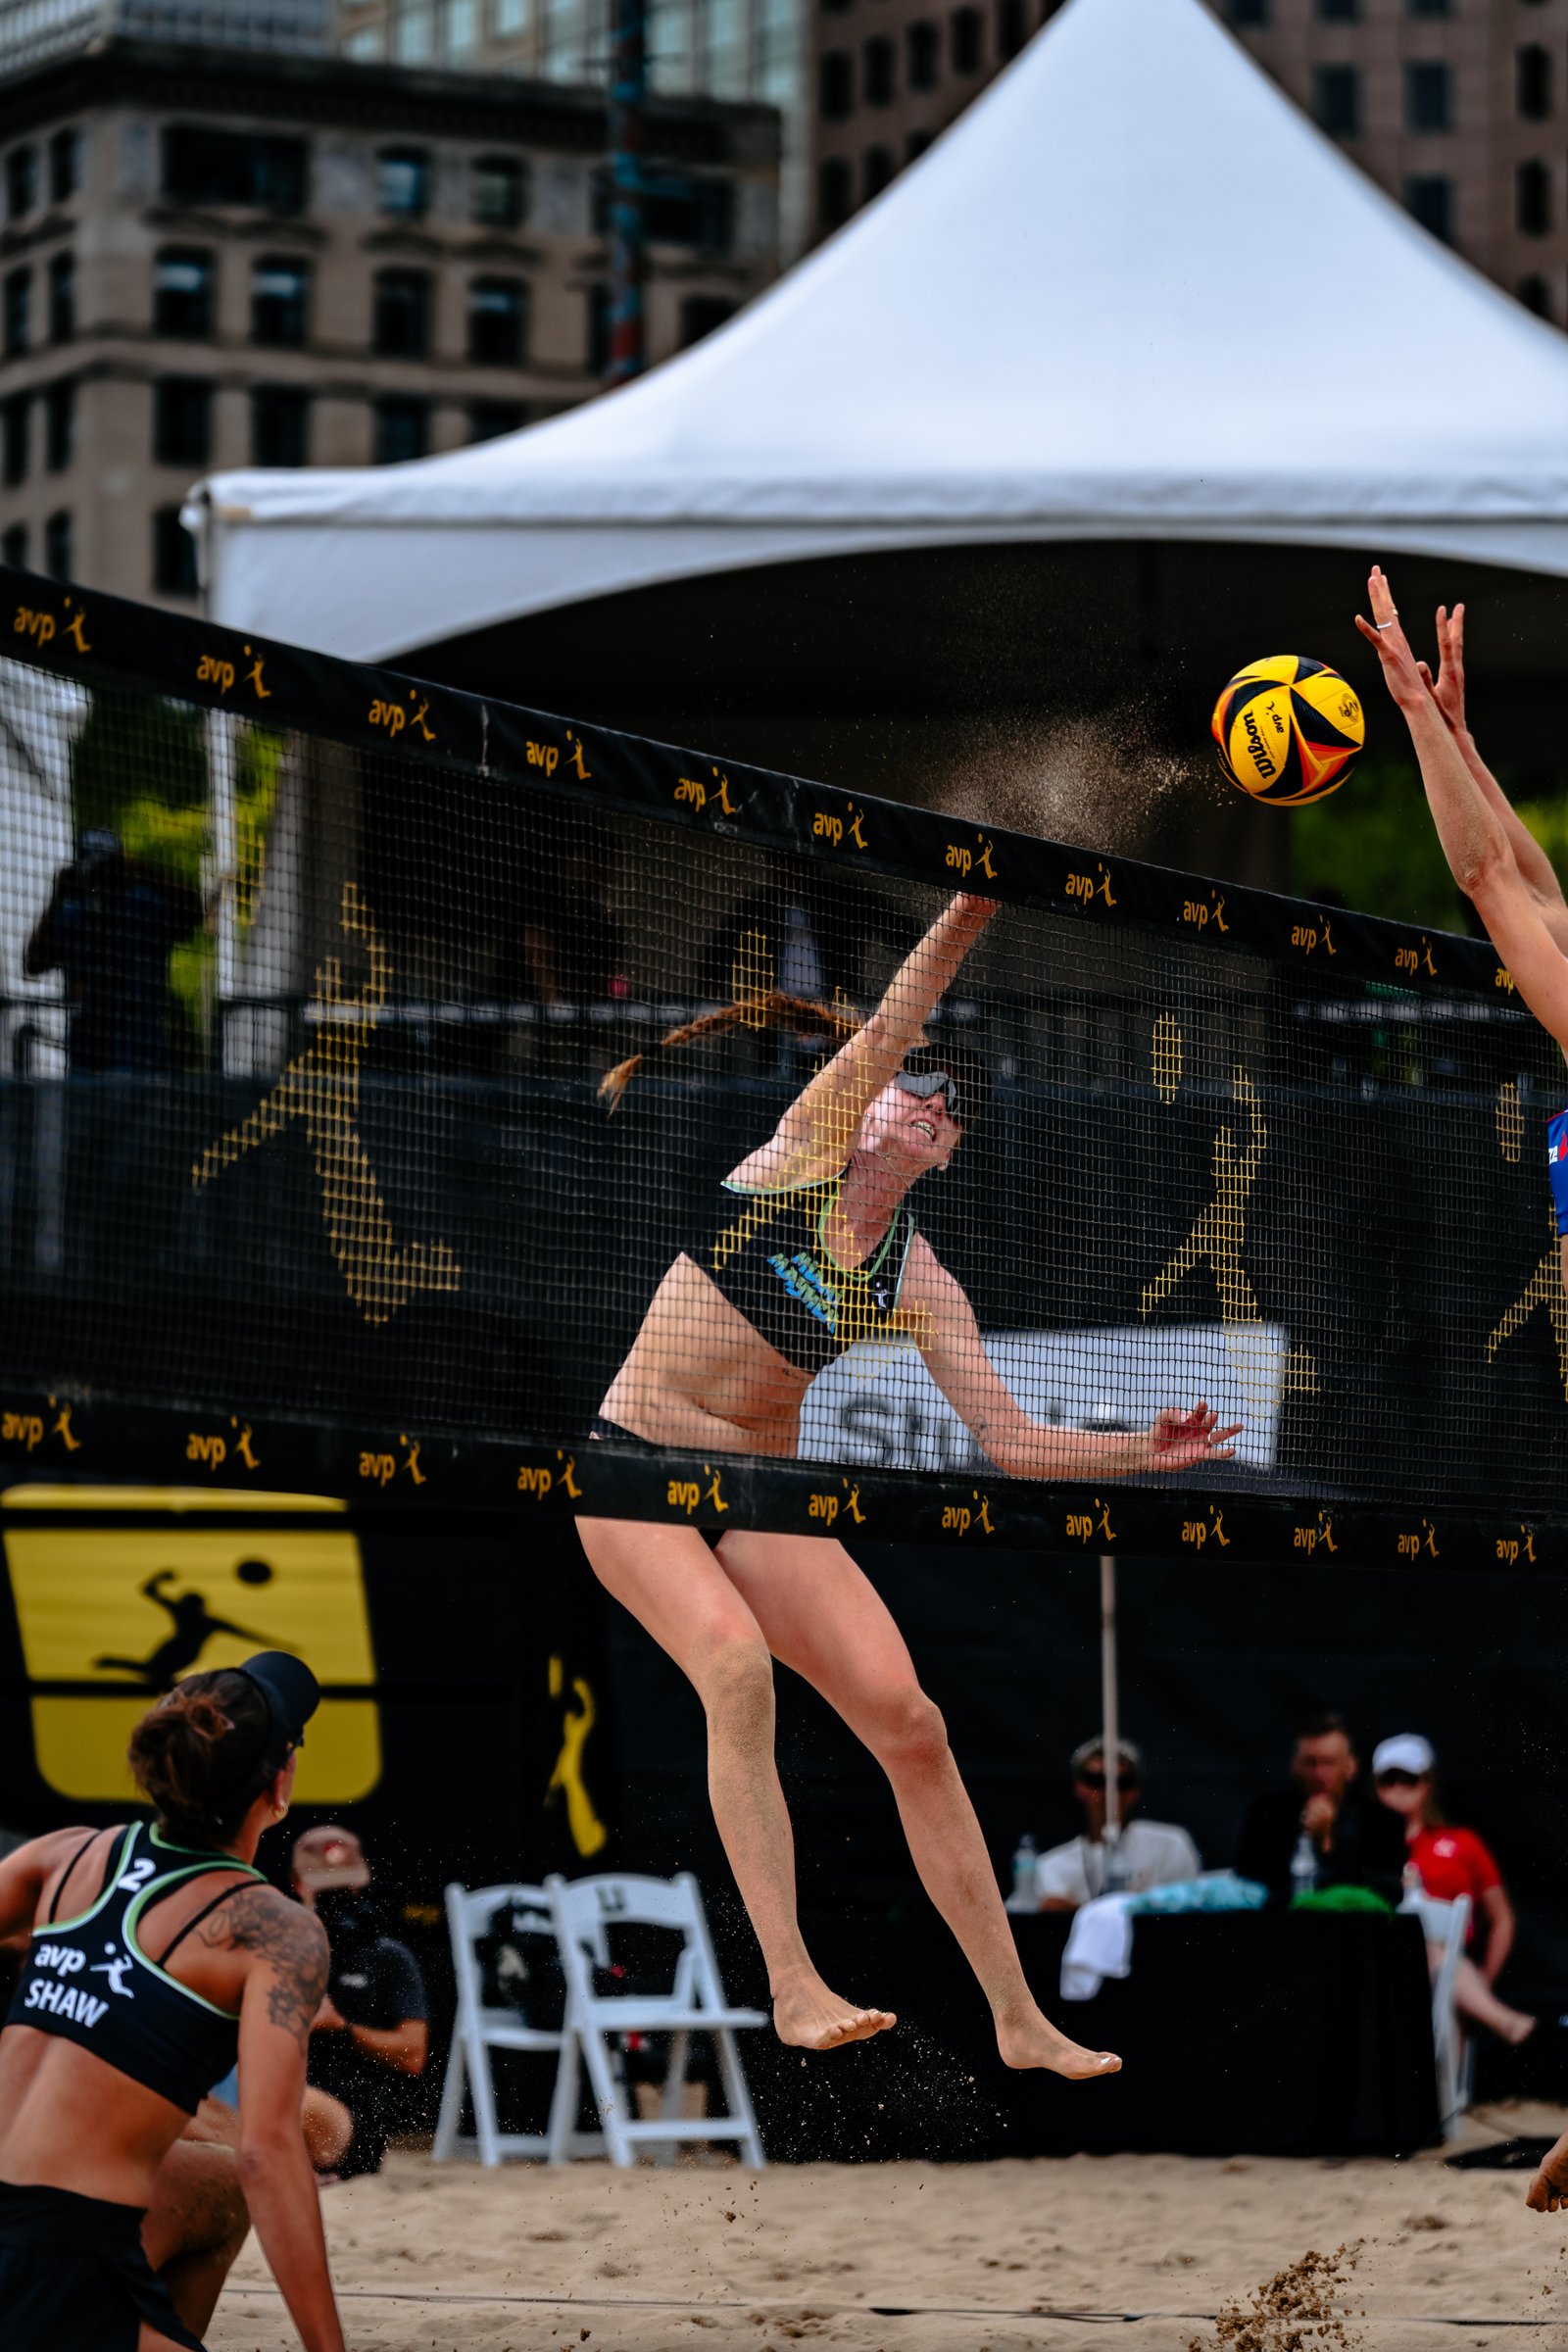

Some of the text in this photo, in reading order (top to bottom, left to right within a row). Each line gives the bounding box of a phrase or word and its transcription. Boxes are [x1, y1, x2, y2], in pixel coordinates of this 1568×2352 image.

[15, 608, 55, 647] avp
[197, 656, 234, 694] avp
[368, 700, 405, 737] avp
[1272, 714, 1284, 733] avp
[526, 742, 559, 776] avp
[1243, 710, 1276, 779] Wilson
[674, 778, 706, 811] avp
[813, 813, 843, 846] avp
[946, 845, 971, 877] avp
[1065, 874, 1093, 905] avp
[1184, 902, 1207, 930] avp
[1292, 926, 1316, 955] avp
[1396, 949, 1417, 973] avp
[2, 1413, 43, 1451] avp
[187, 1434, 225, 1470] avp
[360, 1452, 395, 1486] avp
[517, 1467, 551, 1499] avp
[667, 1481, 700, 1515] avp
[808, 1494, 838, 1526] avp
[942, 1506, 970, 1536] avp
[1066, 1515, 1092, 1544] avp
[1182, 1522, 1206, 1549] avp
[1294, 1528, 1316, 1554] avp
[1398, 1535, 1419, 1559] avp
[1496, 1541, 1518, 1565] avp
[117, 1858, 156, 1892] 2
[34, 1943, 86, 1976] avp
[24, 1978, 110, 2029] SHAW
